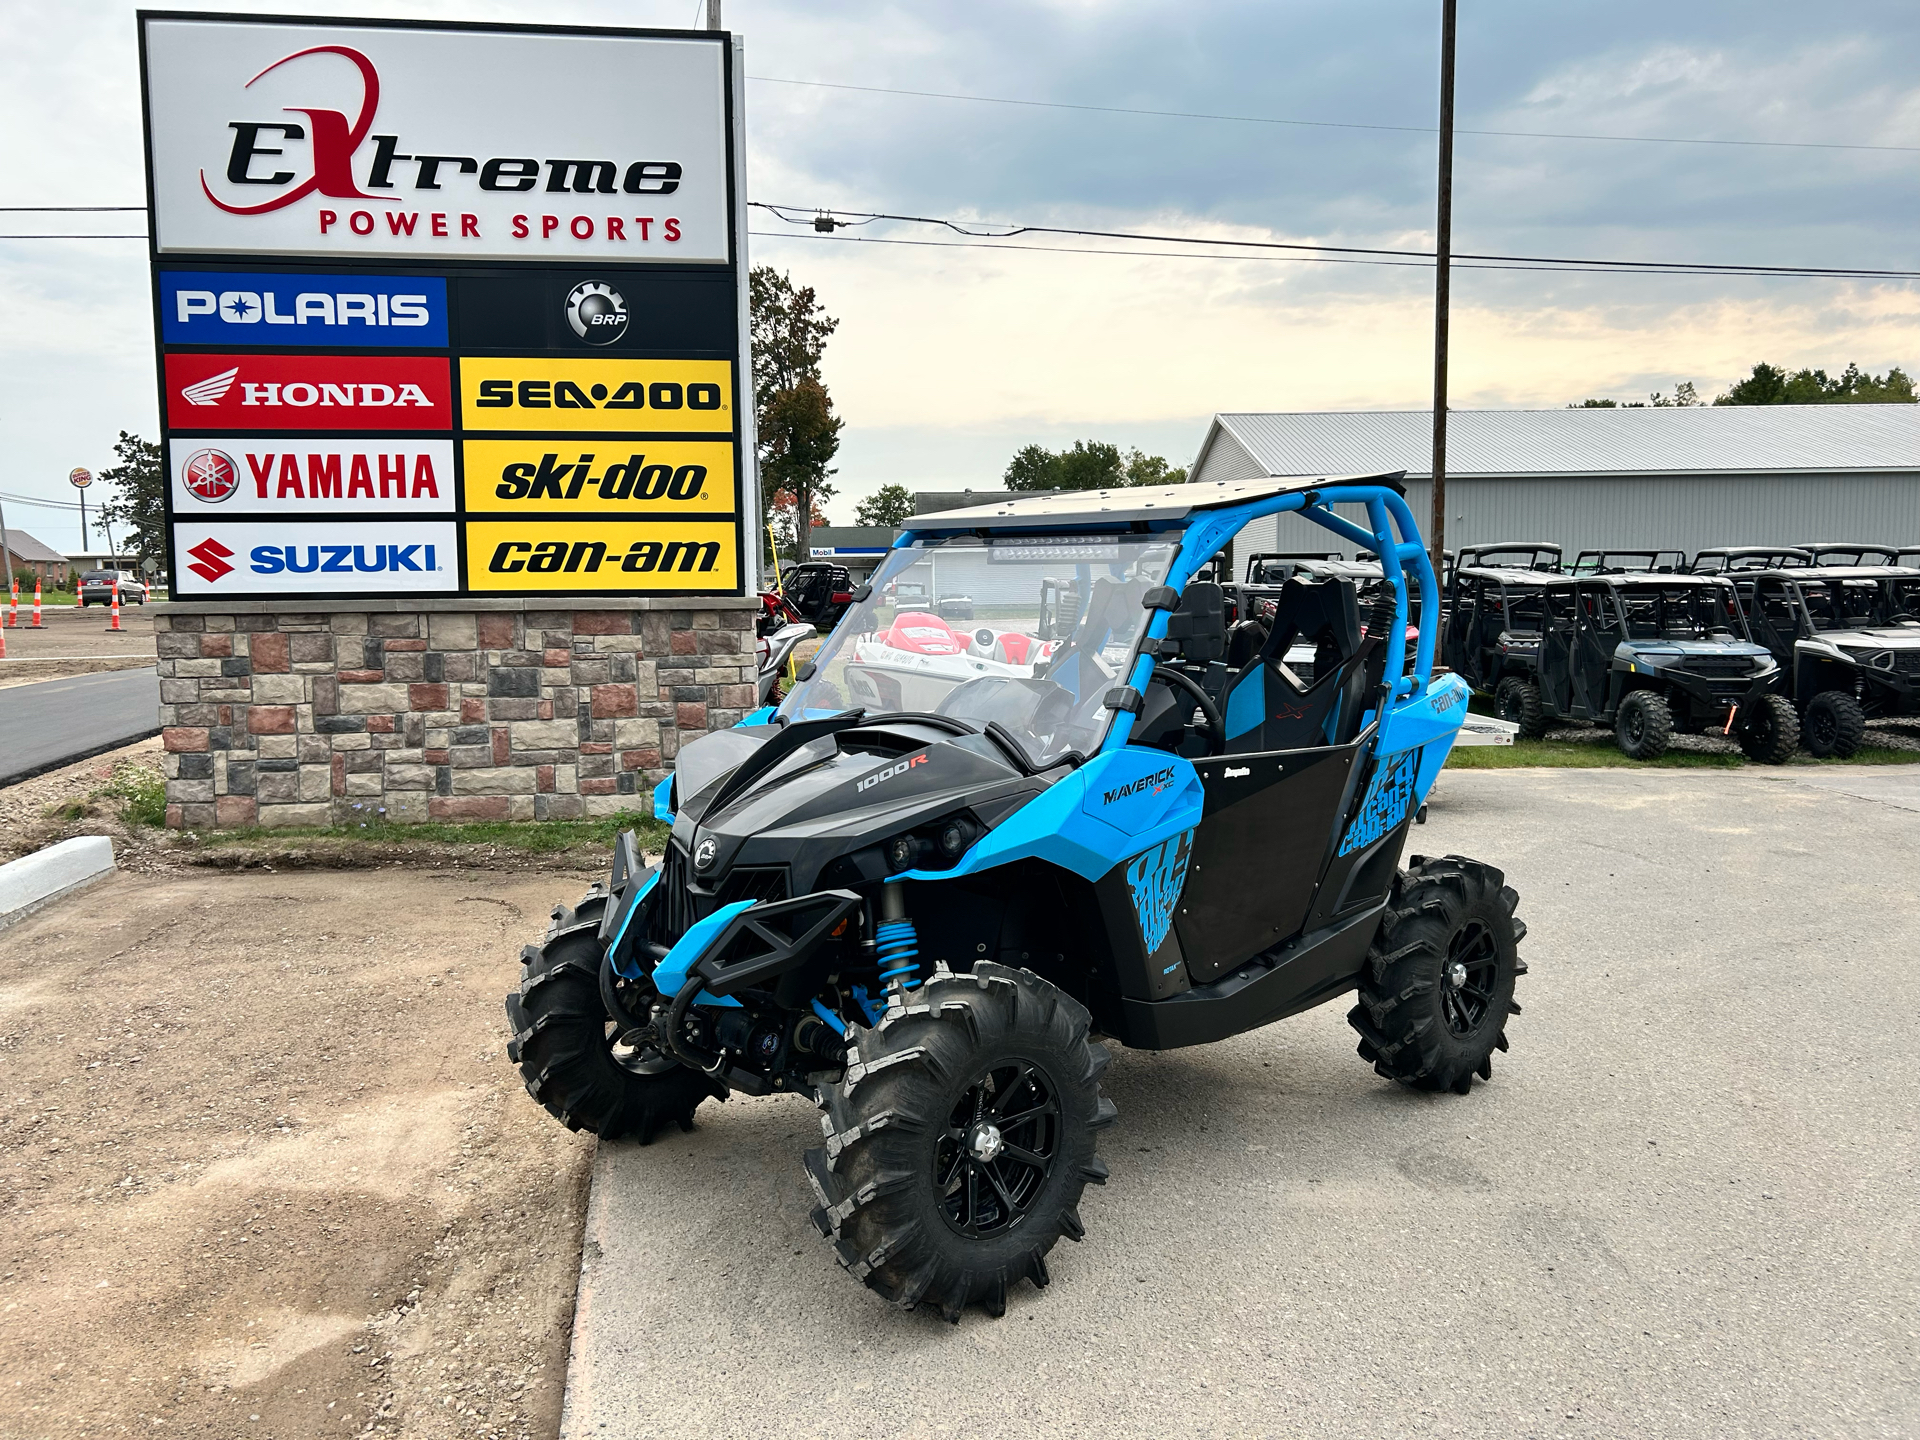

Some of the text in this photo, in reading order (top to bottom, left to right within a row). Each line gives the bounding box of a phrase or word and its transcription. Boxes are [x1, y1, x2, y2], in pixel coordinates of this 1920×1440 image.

[320, 209, 681, 242] POWER SPORTS
[176, 290, 430, 327] POLARIS
[590, 314, 627, 326] BRP
[240, 383, 435, 407] HONDA
[73, 474, 91, 484] KING
[245, 453, 440, 499] YAMAHA
[249, 544, 437, 575] SUZUKI
[488, 540, 721, 573] can-am
[1430, 685, 1466, 715] can-am
[856, 754, 929, 793] 1000R
[1103, 765, 1176, 806] MAVERICK
